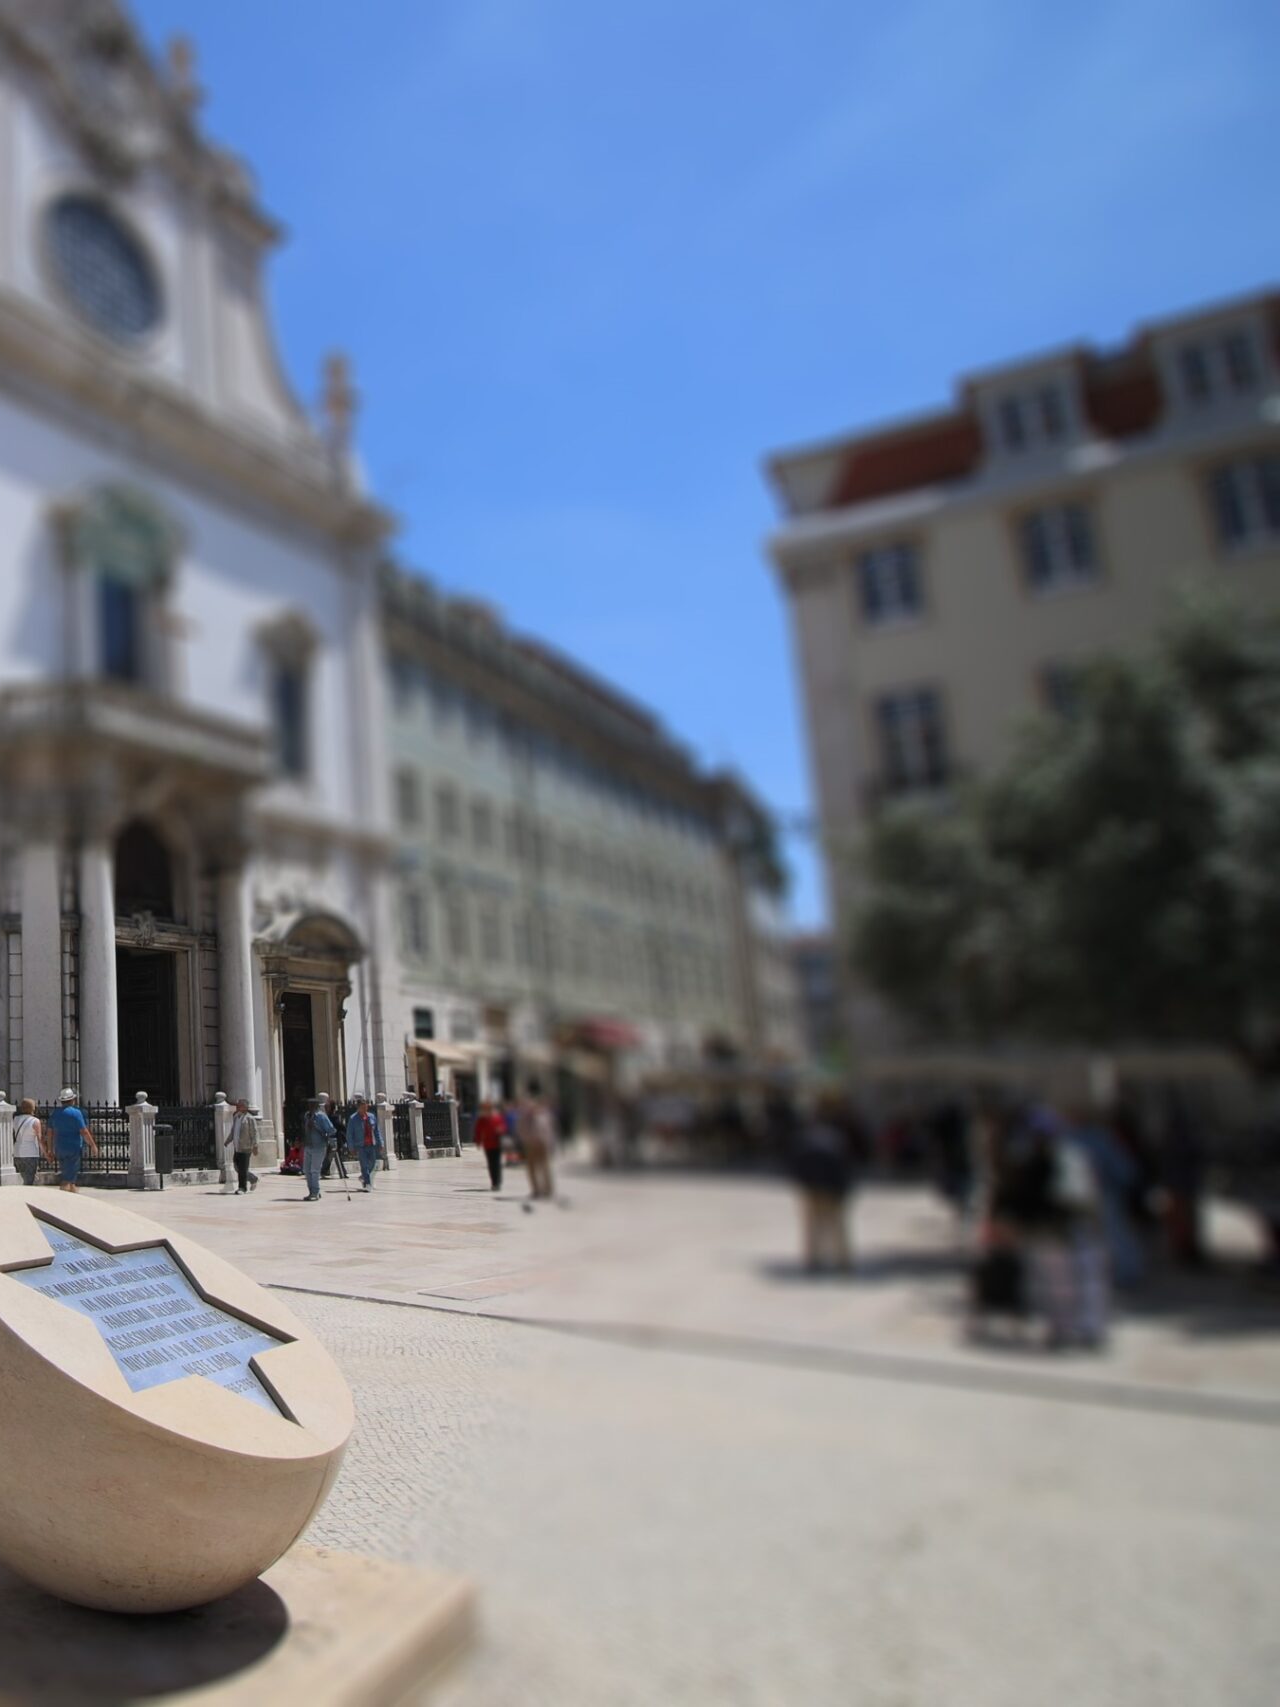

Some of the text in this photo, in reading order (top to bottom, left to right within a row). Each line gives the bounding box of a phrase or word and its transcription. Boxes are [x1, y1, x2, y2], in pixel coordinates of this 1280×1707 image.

[51, 1276, 104, 1296] MILHARES
[95, 1274, 116, 1287] DE
[110, 1268, 147, 1285] JUDEUS
[59, 1260, 83, 1275] EM
[79, 1297, 102, 1312] DA
[155, 1281, 176, 1295] DO
[99, 1297, 195, 1329] FANATISMO RELIGIOSO
[105, 1310, 228, 1351] ASSASSINADOS NO MASSACRE
[119, 1325, 252, 1372] INICIADO A 19 DE ABRIL DE 1506
[180, 1351, 241, 1376] NESTE LARGO
